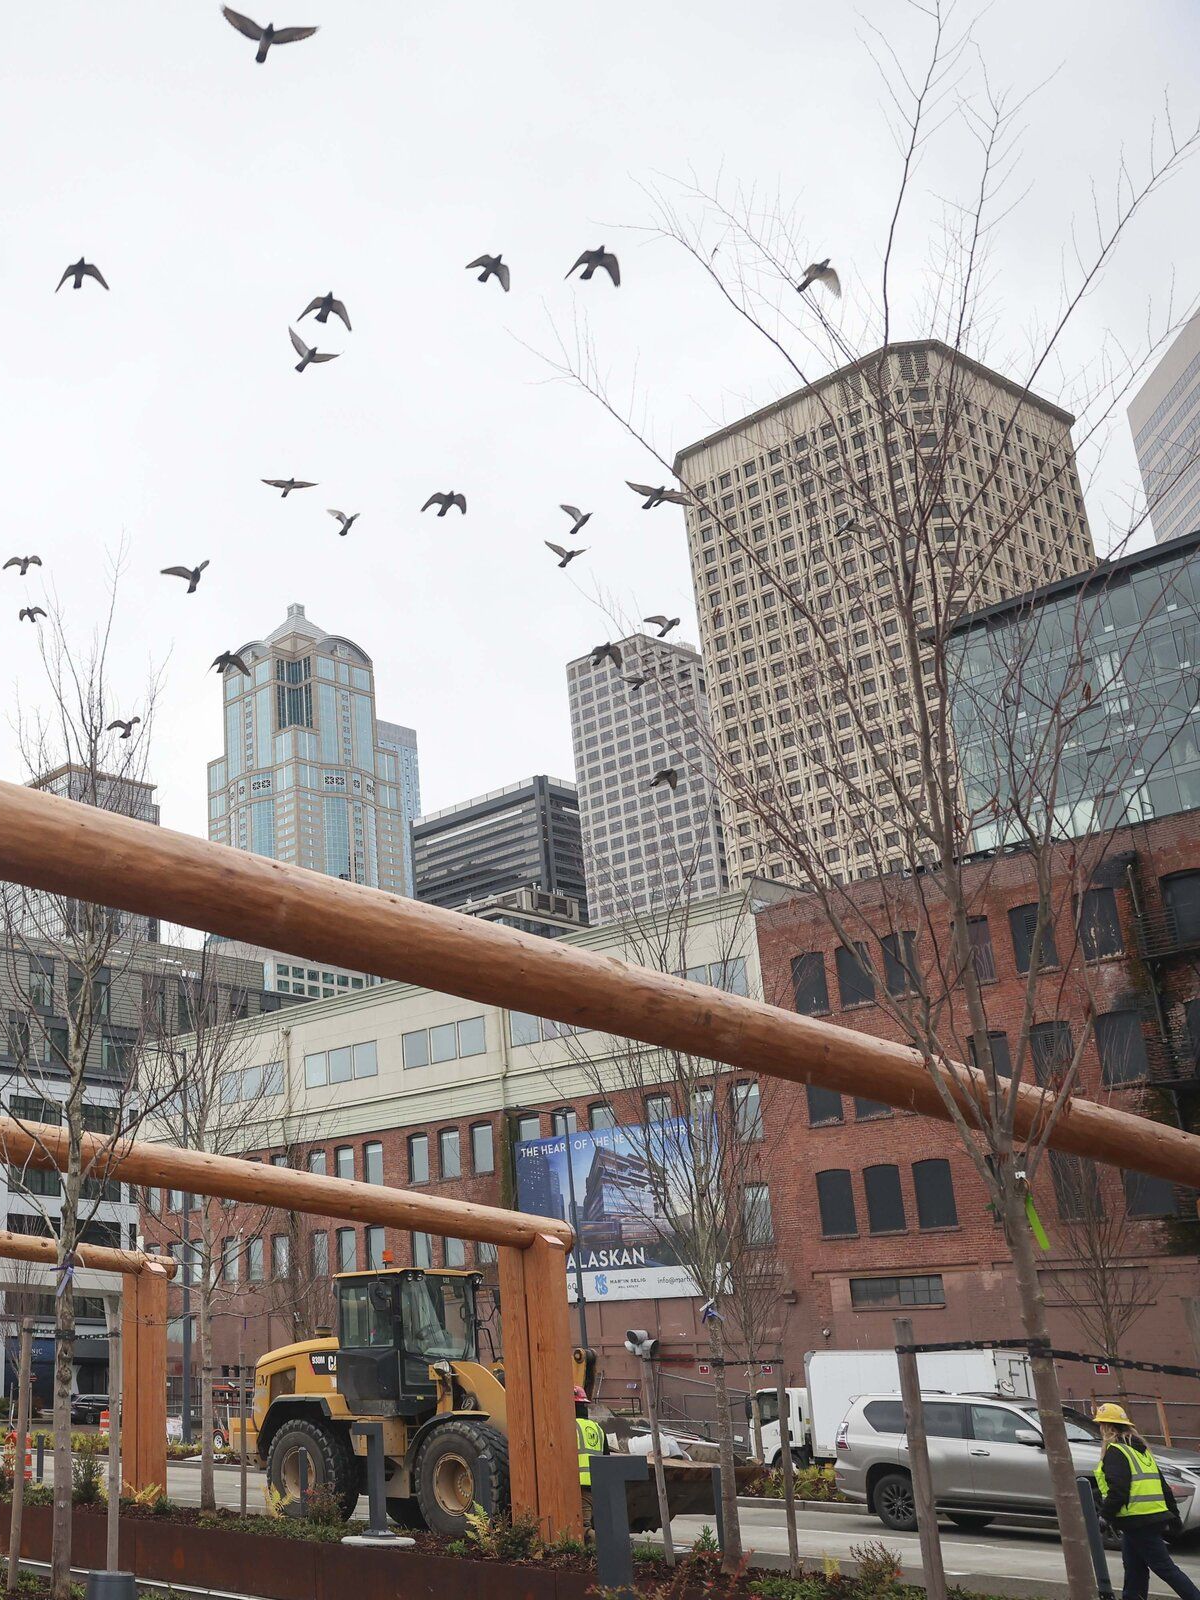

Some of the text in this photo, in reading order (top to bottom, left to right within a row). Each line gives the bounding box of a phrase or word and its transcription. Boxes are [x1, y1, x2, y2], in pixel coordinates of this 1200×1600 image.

[521, 1146, 539, 1158] THE
[541, 1141, 572, 1155] HEAR
[574, 1139, 588, 1150] OF
[590, 1136, 609, 1147] THE
[566, 1247, 646, 1270] ALASKAN
